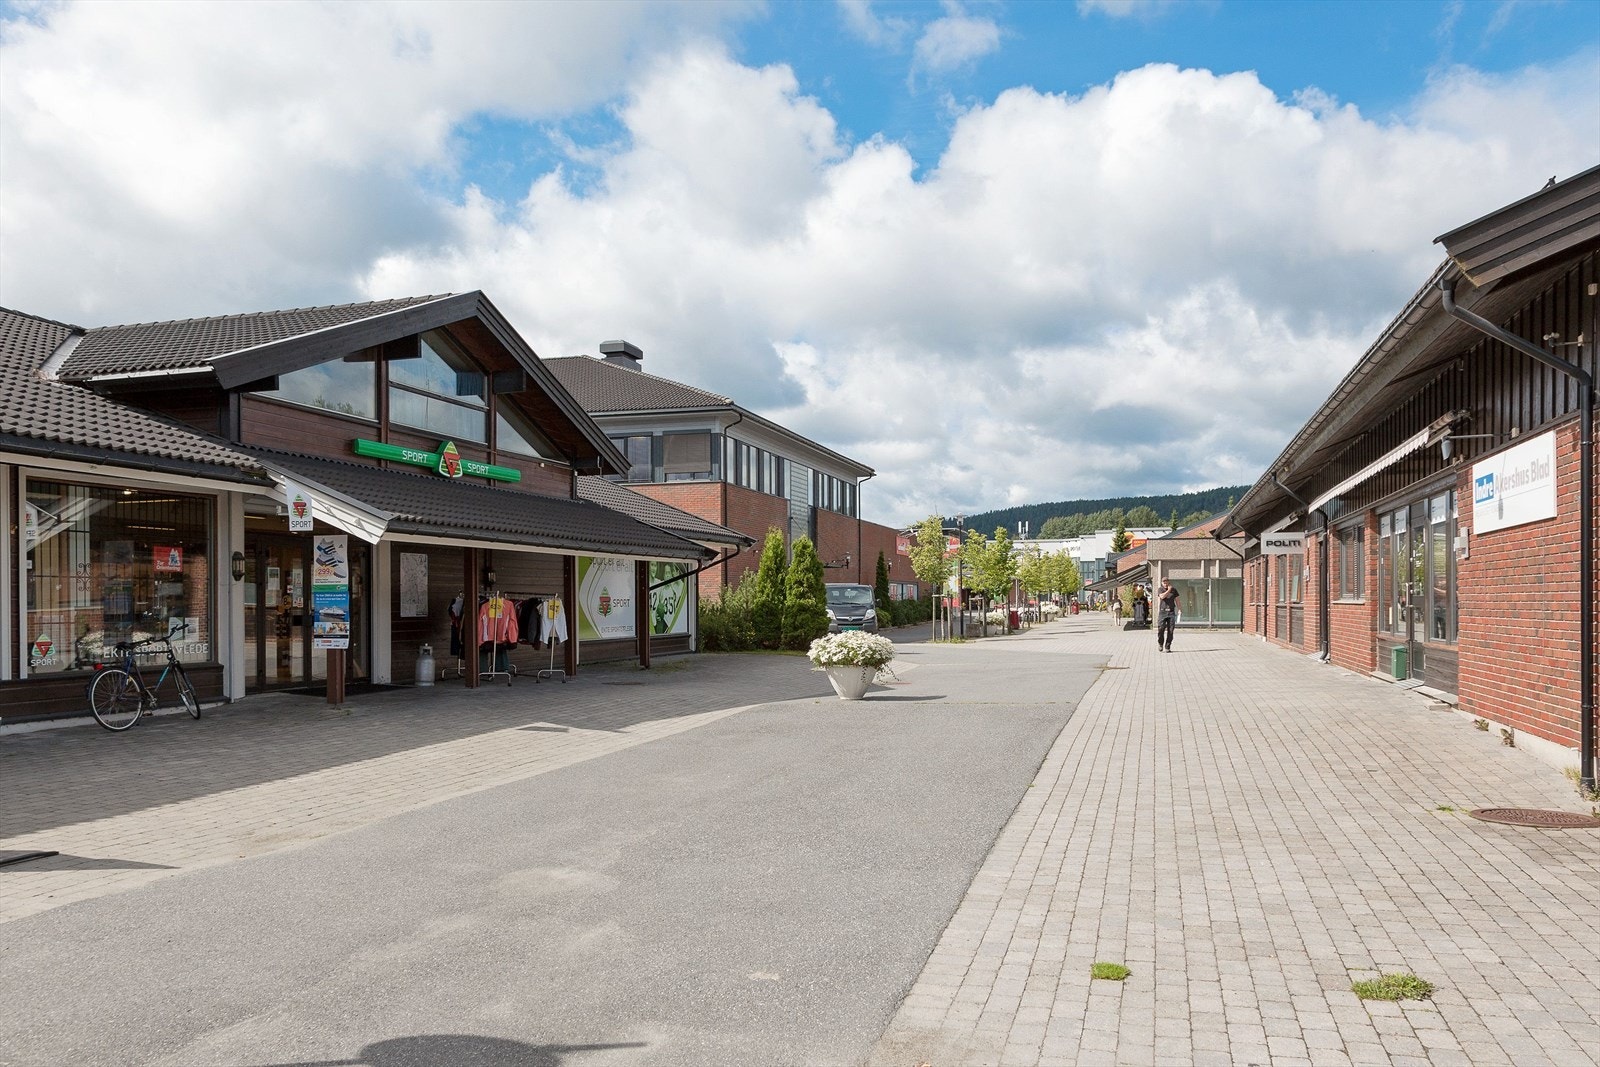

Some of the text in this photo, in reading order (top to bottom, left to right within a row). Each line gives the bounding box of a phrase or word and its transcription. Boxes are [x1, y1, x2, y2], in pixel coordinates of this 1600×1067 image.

[402, 450, 428, 463] SPORT
[467, 463, 489, 475] SPORT
[1495, 467, 1529, 494] Akershus
[1531, 454, 1550, 483] Blad
[291, 520, 311, 529] SPORT
[613, 599, 630, 608] SPORT
[31, 658, 57, 667] SPORT
